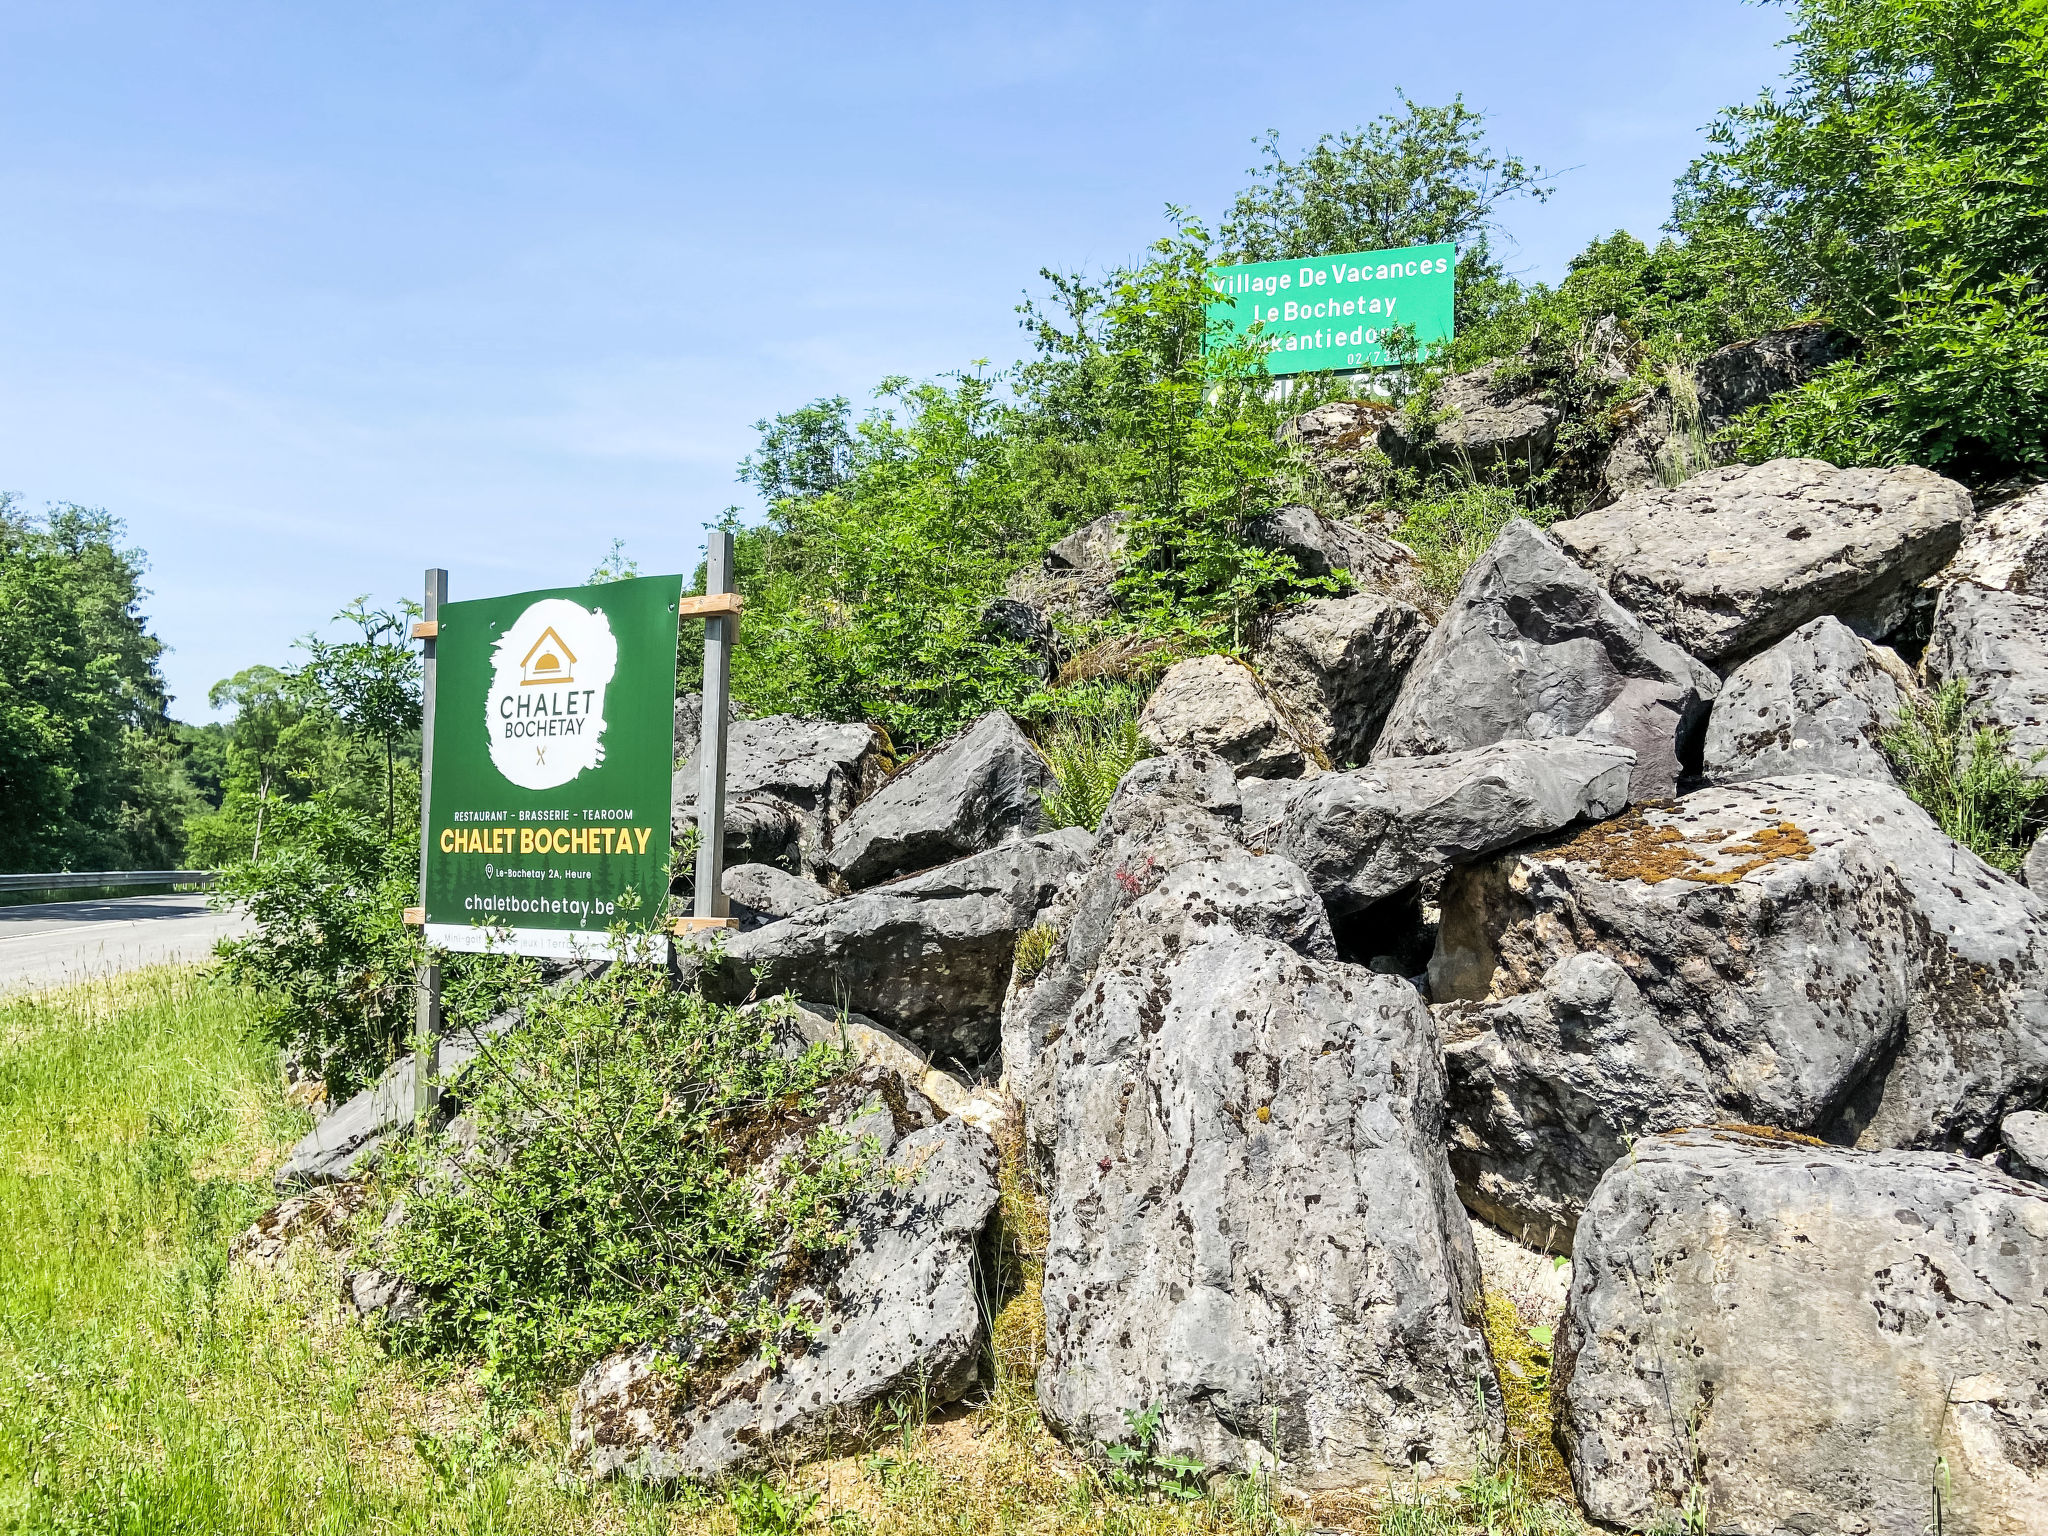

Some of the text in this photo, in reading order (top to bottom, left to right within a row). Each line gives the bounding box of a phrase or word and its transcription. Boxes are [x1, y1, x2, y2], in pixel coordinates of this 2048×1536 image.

[1213, 257, 1448, 297] Village De Vacances
[1254, 297, 1397, 324] Le Bochetay
[500, 689, 595, 720] CHALET
[505, 717, 586, 738] BOCHETAY
[454, 811, 507, 822] RESTAURANT
[519, 809, 569, 821] BRASSERIE
[582, 809, 633, 820] TEAROOM
[440, 827, 652, 855] CHALET BOCHETAY
[495, 868, 592, 880] Le-Bochetay 2A, Heure
[464, 893, 615, 918] chaletbochetay.be
